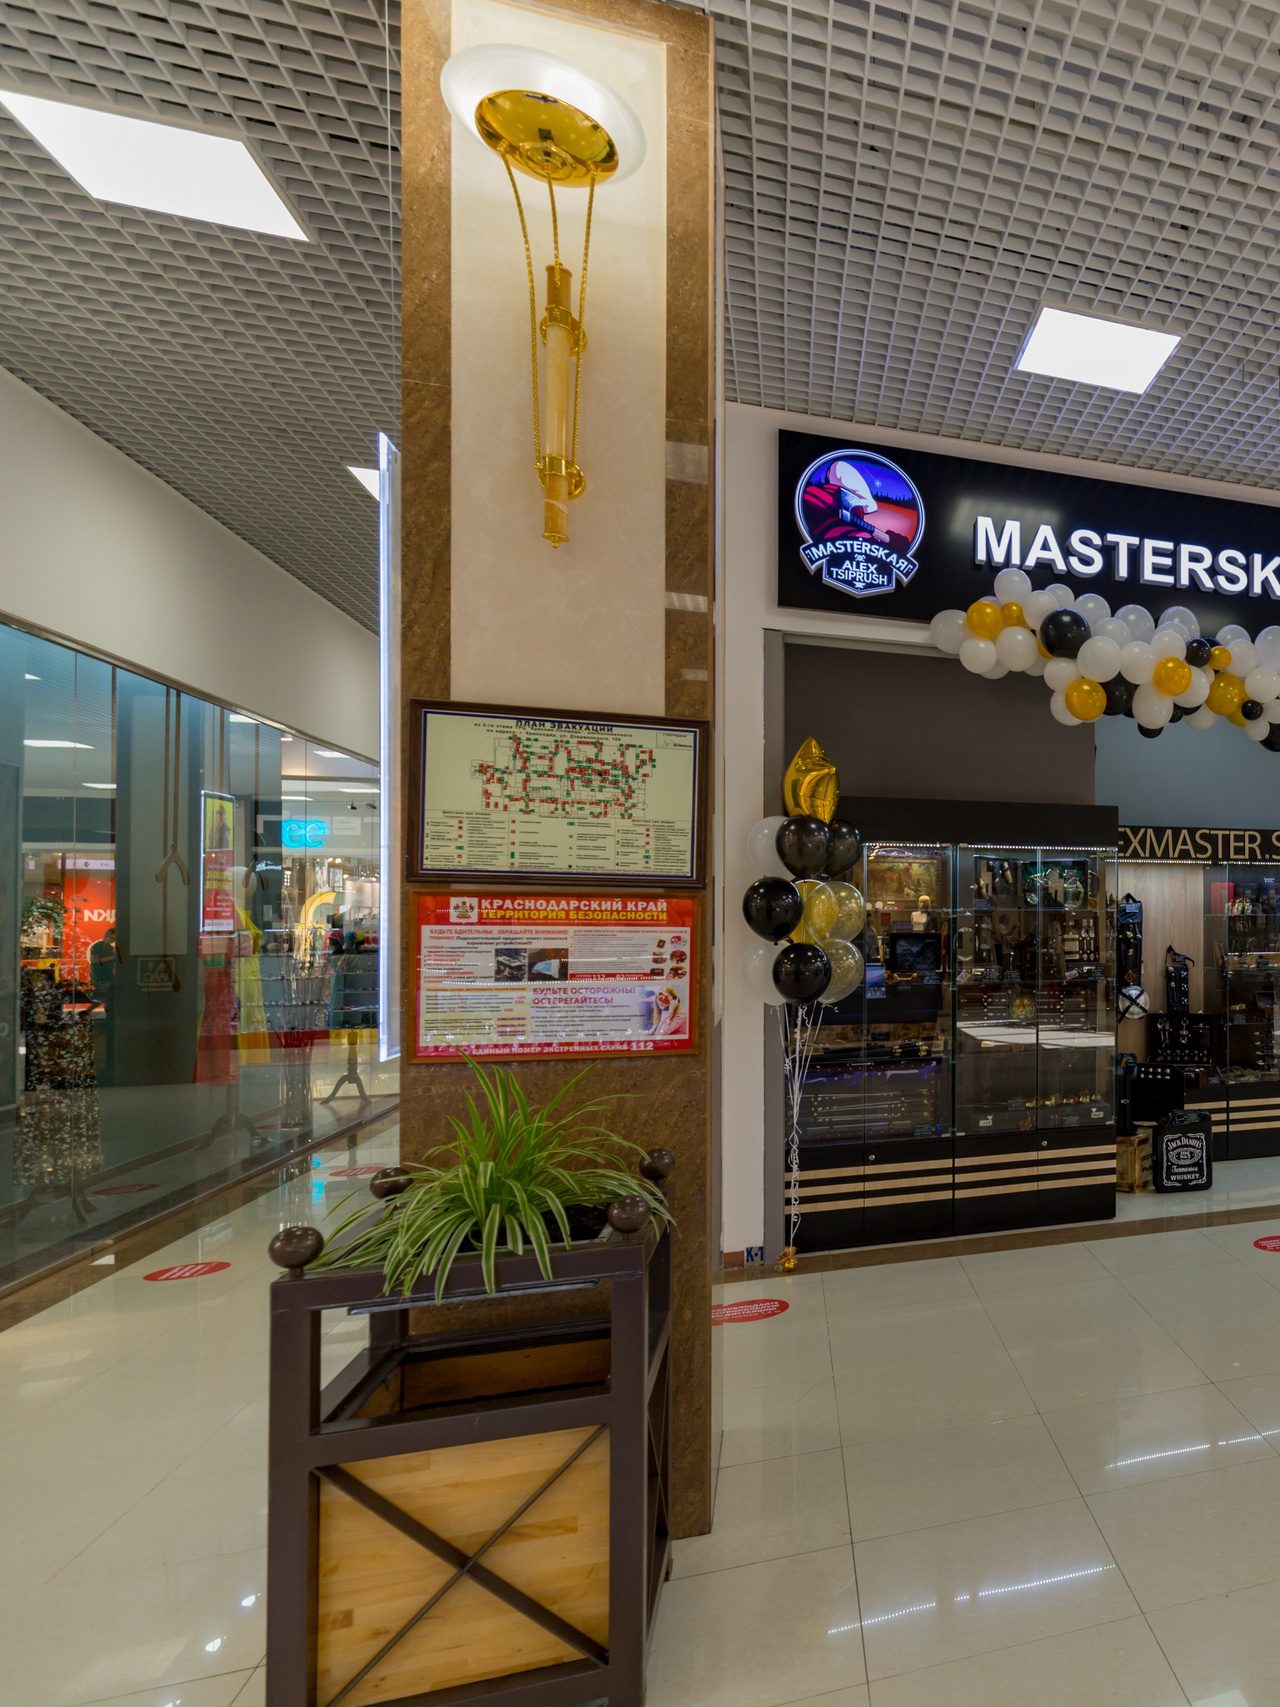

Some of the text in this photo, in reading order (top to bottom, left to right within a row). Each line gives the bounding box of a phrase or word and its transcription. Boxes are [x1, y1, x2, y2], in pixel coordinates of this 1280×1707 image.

[842, 560, 878, 575] ALEX
[830, 567, 888, 586] TSIPRUSH
[516, 720, 614, 733] ПЛАН ЭВАКУАЦИИ
[481, 898, 667, 911] КРАСНОДАРСКИЙ КРАЙ
[481, 910, 667, 920] ТЕРРИТОРИЯ БЕЗОПАСНОСТИ
[532, 987, 636, 996] БУДЬТЕ ОСТОРОЖНЫ!
[532, 996, 614, 1005] ОСТЕРЕГАЙТЕСЬ!
[472, 1046, 510, 1055] ЕДИНЫЙ
[512, 1046, 541, 1054] НОМЕР
[630, 1042, 654, 1051] 112
[1168, 1138, 1181, 1150] JACK
